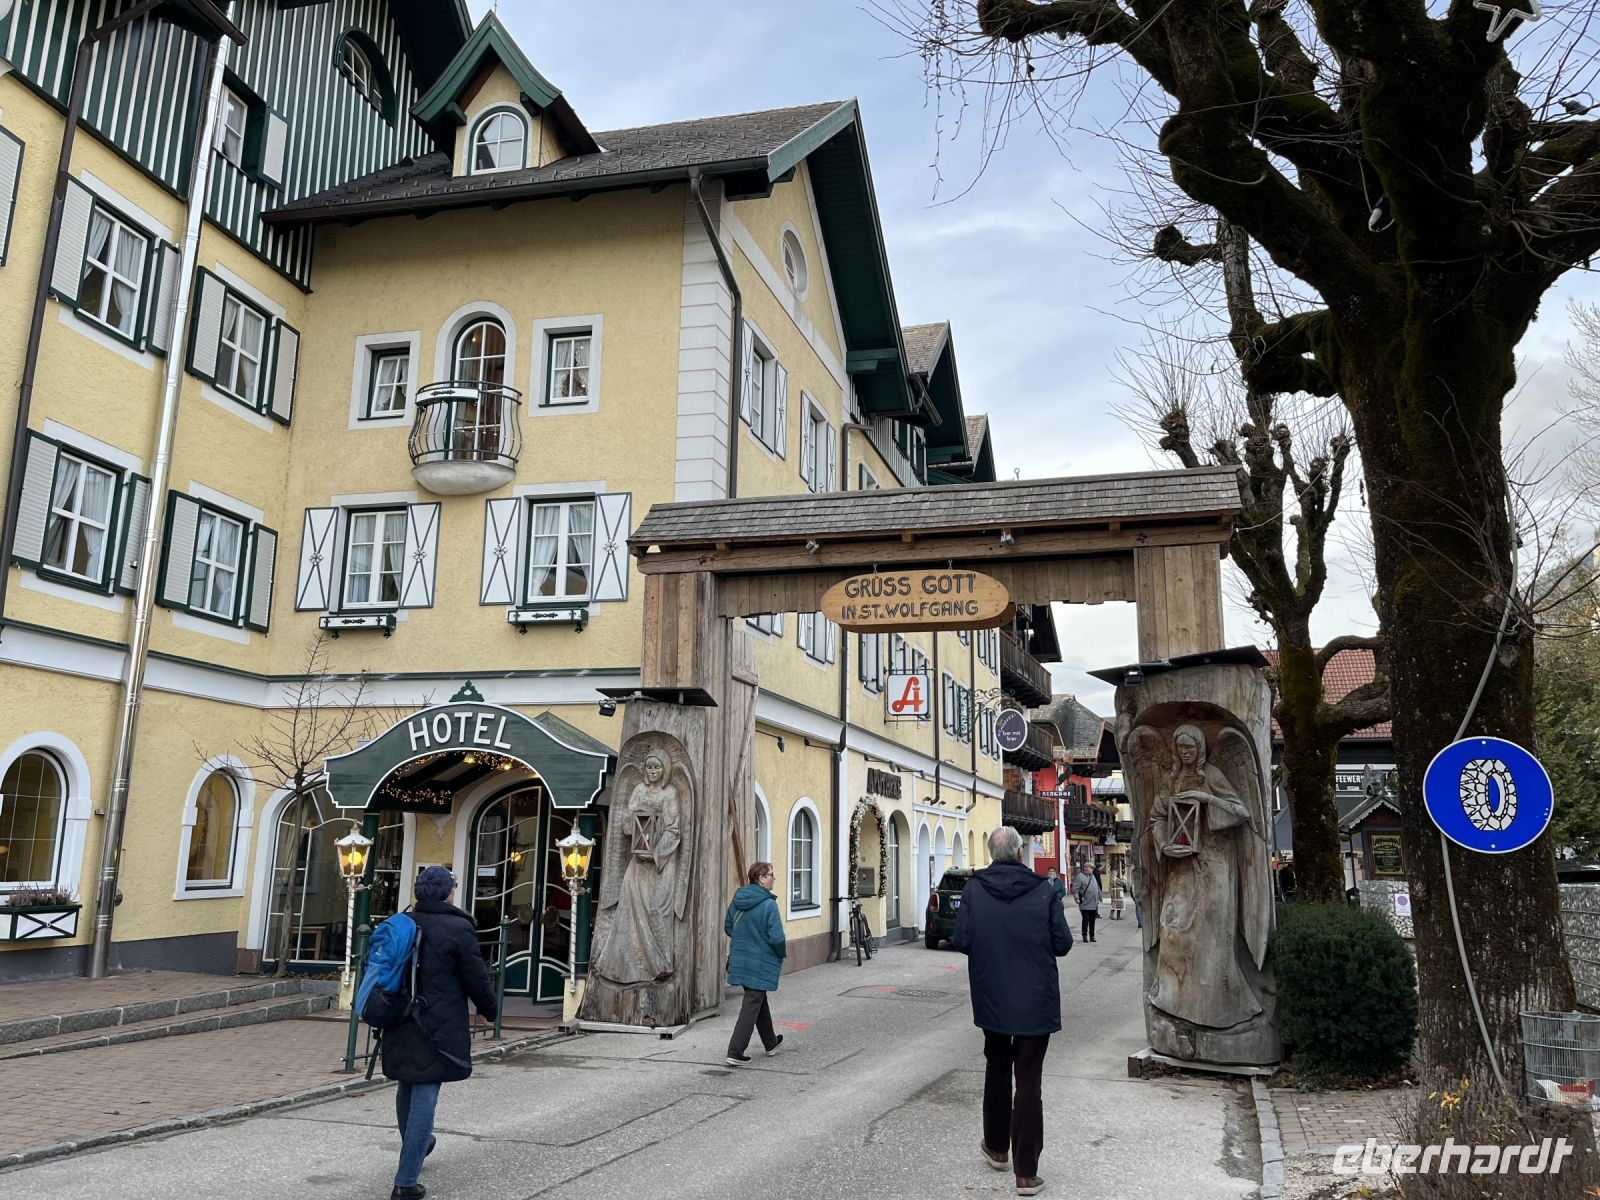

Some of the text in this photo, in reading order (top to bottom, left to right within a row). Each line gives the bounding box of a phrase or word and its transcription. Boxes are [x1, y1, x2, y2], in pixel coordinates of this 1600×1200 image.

[845, 574, 976, 598] GRÜSS GOTT
[842, 604, 857, 620] IN
[408, 712, 511, 751] HOTEL
[1336, 774, 1364, 783] FEEWER
